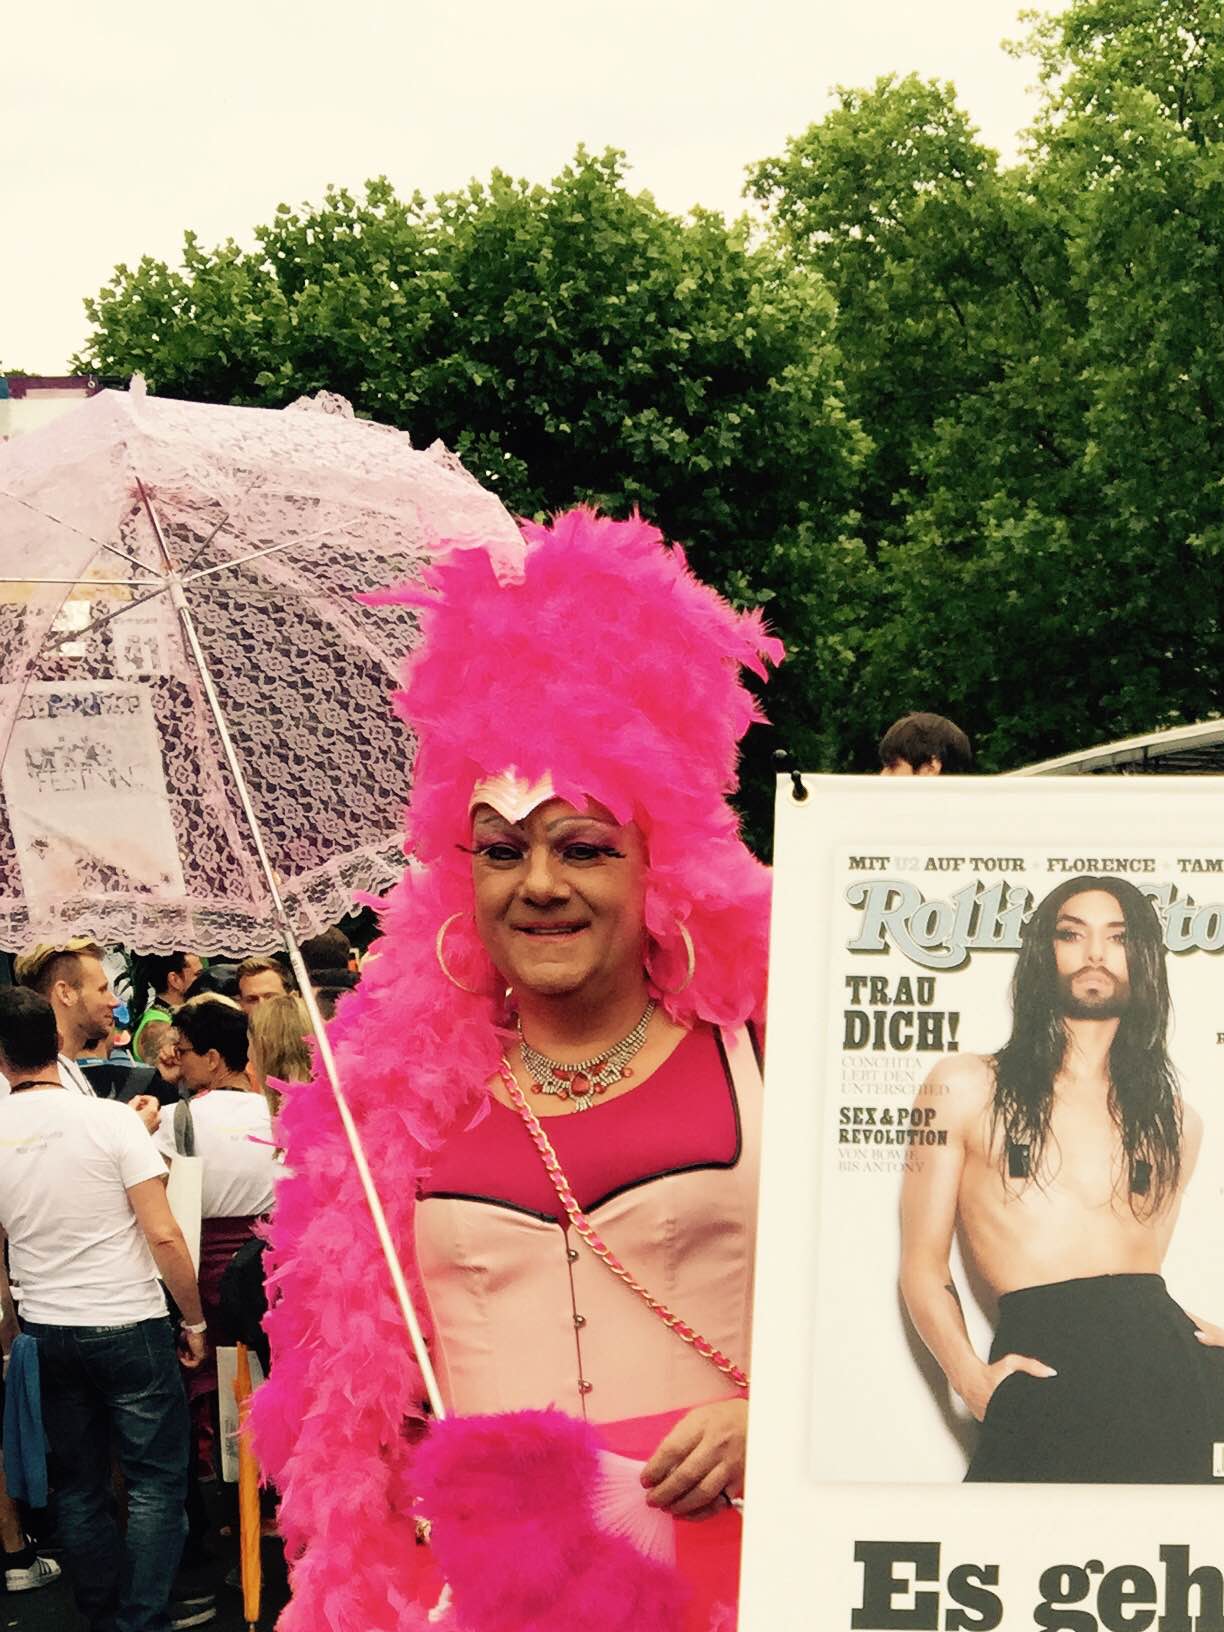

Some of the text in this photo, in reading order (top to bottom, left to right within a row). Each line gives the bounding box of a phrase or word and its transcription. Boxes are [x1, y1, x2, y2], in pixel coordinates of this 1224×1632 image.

[848, 856, 890, 871] MIT
[925, 857, 965, 872] AUF
[970, 857, 1026, 872] TOUR
[1046, 857, 1156, 873] FLORENCE
[844, 975, 936, 1007] TRAU
[842, 1010, 960, 1052] DICH!
[841, 1056, 922, 1068] CONCHITA
[884, 1070, 915, 1082] DEN
[840, 1083, 950, 1096] UNTERSCHIED
[839, 1107, 937, 1127] SEX & POP
[838, 1128, 949, 1147] REVOLUTION
[838, 1148, 917, 1161] VON BOWIE
[838, 1161, 925, 1175] BIS ANTONY
[851, 1541, 1004, 1632] Es
